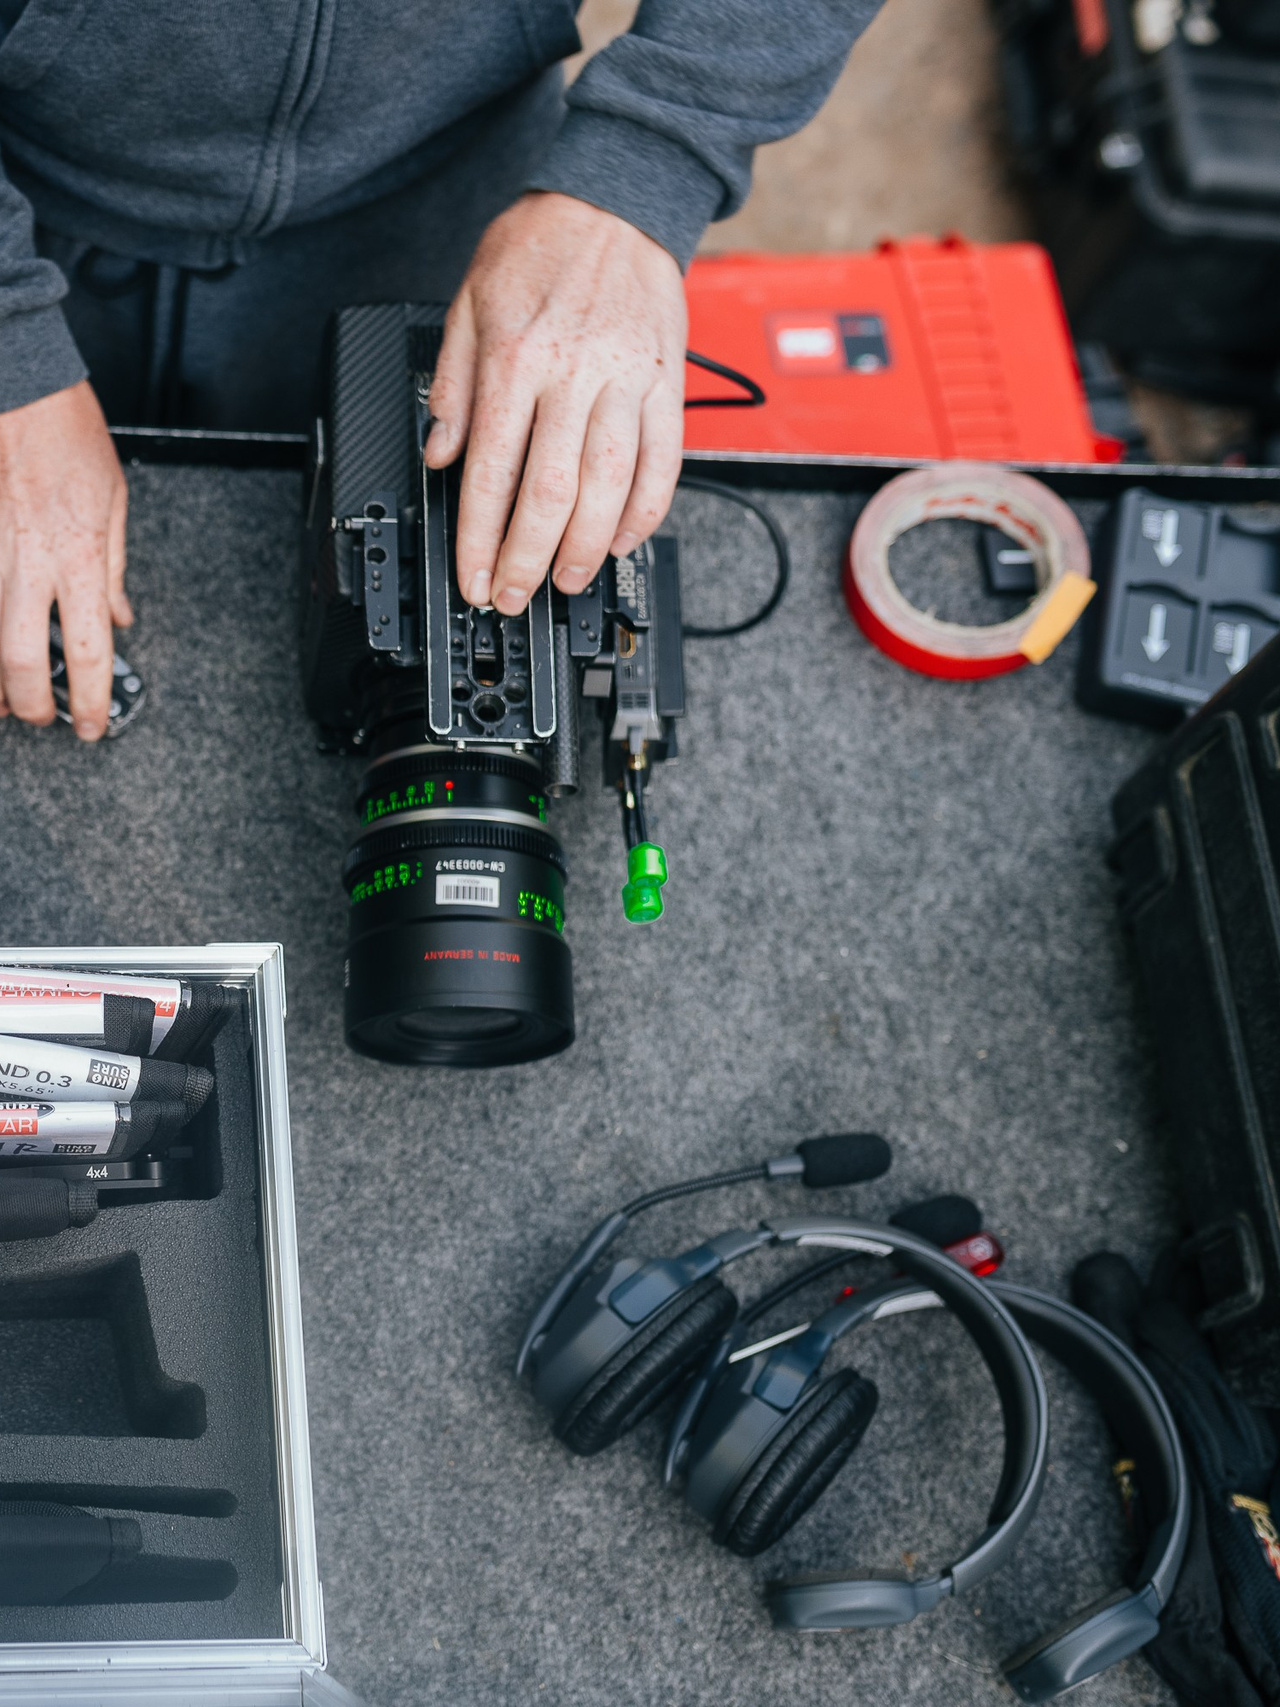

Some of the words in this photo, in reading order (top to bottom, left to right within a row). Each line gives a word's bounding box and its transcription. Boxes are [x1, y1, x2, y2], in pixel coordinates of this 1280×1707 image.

[424, 949, 473, 961] GERMANY
[478, 950, 488, 959] IN
[493, 950, 520, 963] MADE
[93, 1062, 130, 1078] SURF
[36, 1071, 72, 1088] 0.3
[86, 1165, 109, 1179] 4x4
